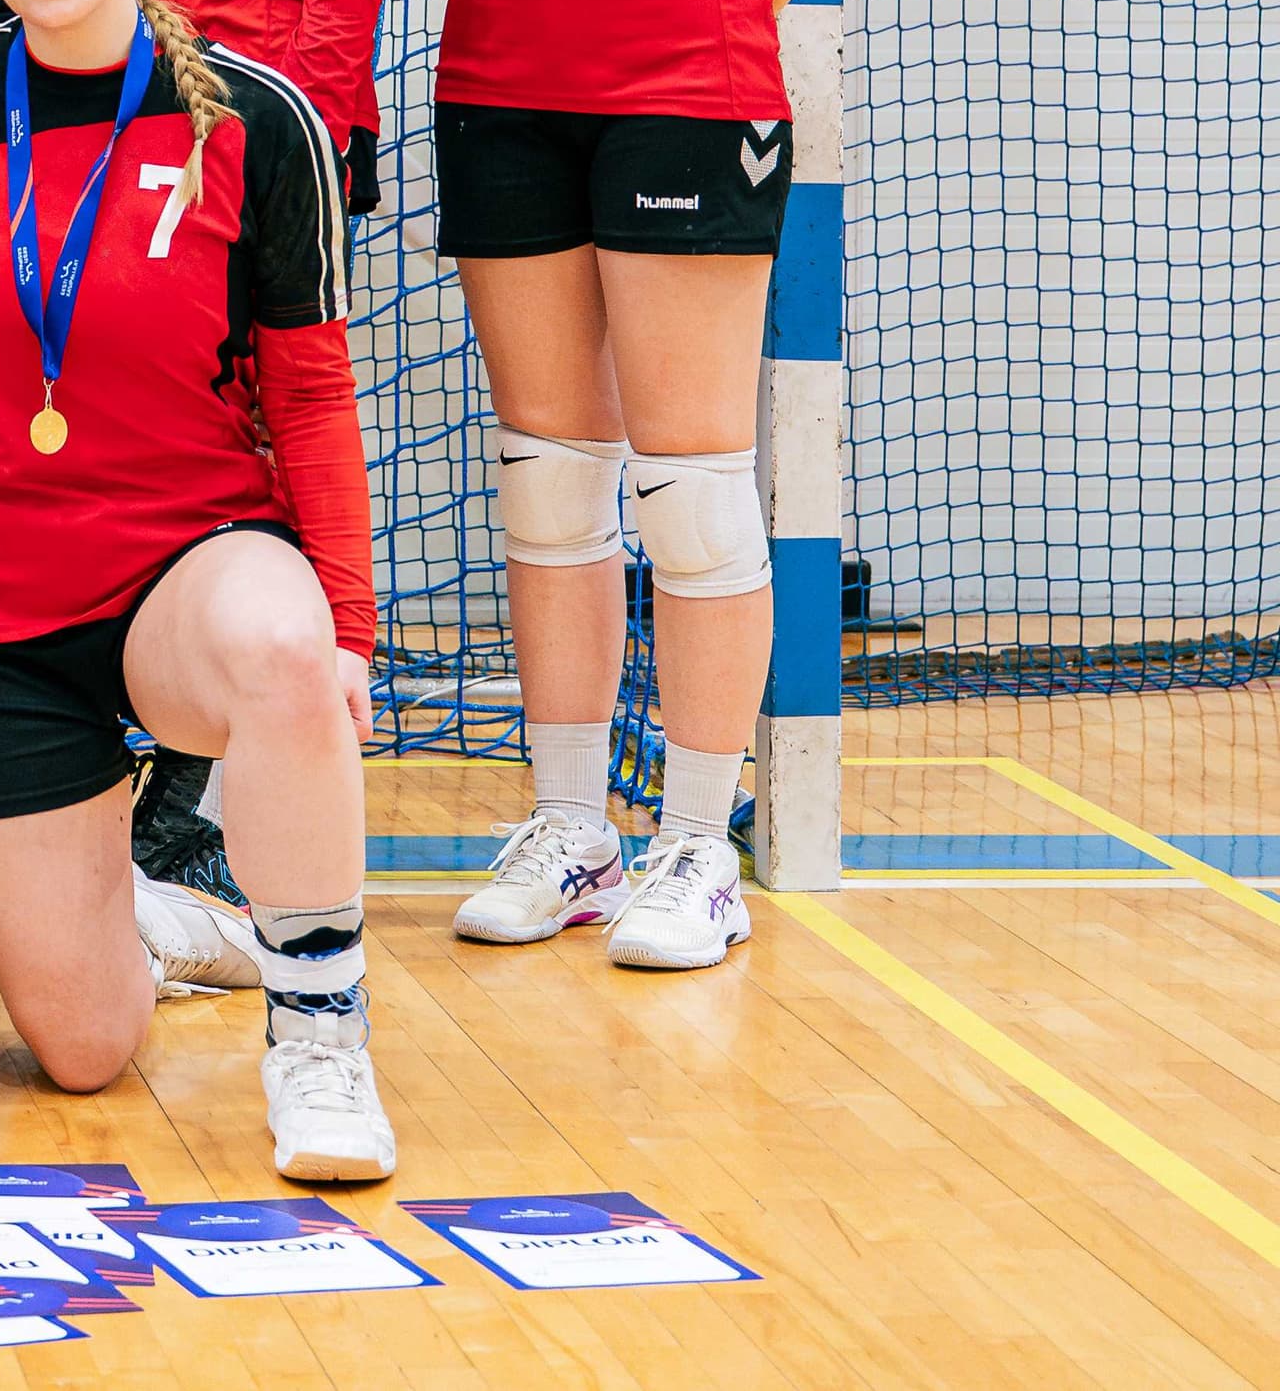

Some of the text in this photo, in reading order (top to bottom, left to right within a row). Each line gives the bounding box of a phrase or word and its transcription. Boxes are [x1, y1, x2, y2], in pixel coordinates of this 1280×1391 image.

[636, 193, 700, 210] hummel
[138, 163, 187, 259] 7
[185, 1240, 346, 1257] DIPLOM
[499, 1234, 660, 1250] DIPLOM
